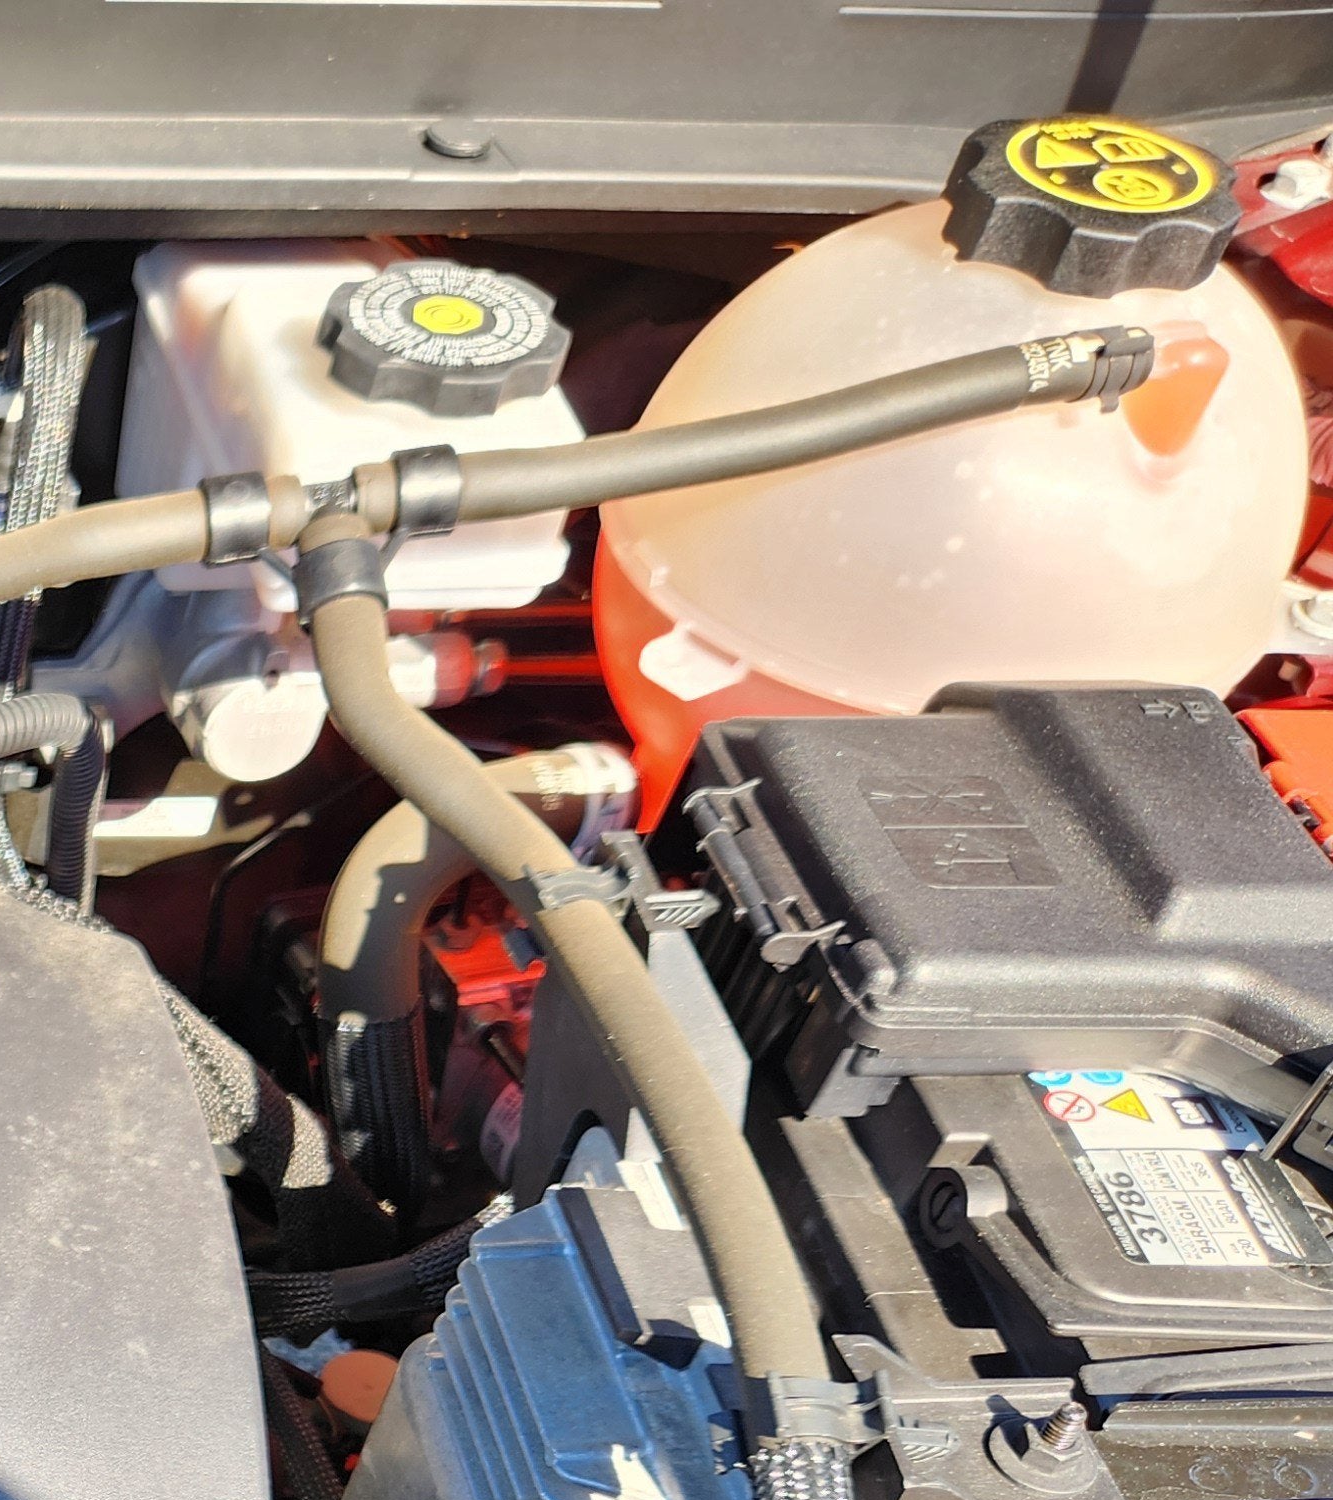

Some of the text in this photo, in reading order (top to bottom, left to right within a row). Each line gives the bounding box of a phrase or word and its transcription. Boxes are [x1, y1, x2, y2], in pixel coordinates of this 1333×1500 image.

[1043, 338, 1073, 372] TNK
[1102, 1172, 1169, 1243] 3786
[1217, 1155, 1291, 1254] ACDelco
[1236, 1238, 1258, 1257] 730
